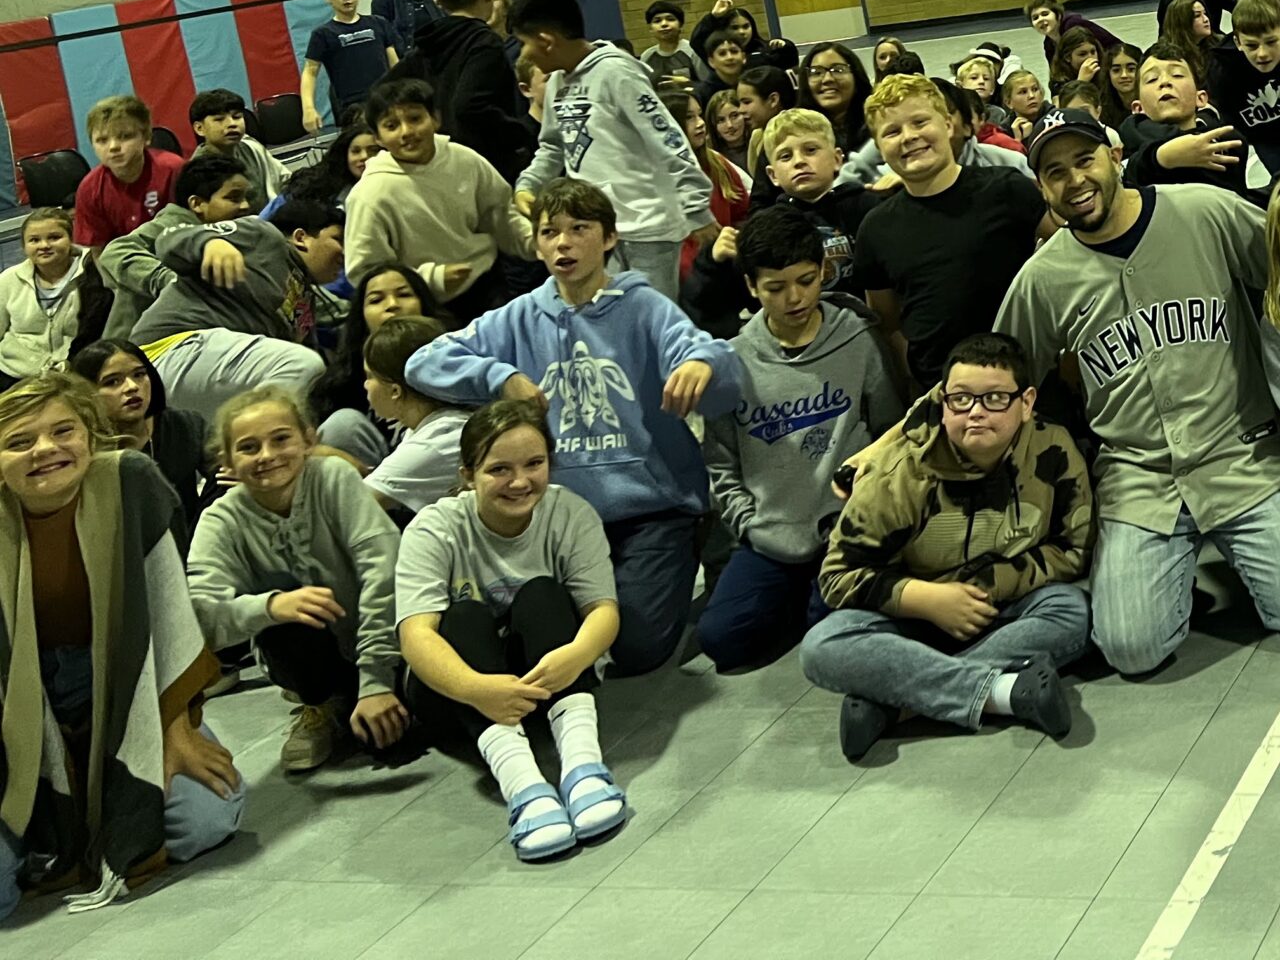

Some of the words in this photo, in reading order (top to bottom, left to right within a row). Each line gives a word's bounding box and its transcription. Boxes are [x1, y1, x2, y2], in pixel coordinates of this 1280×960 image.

[1077, 313, 1144, 389] NEW
[1136, 297, 1231, 351] YORK
[732, 380, 845, 427] Cascade
